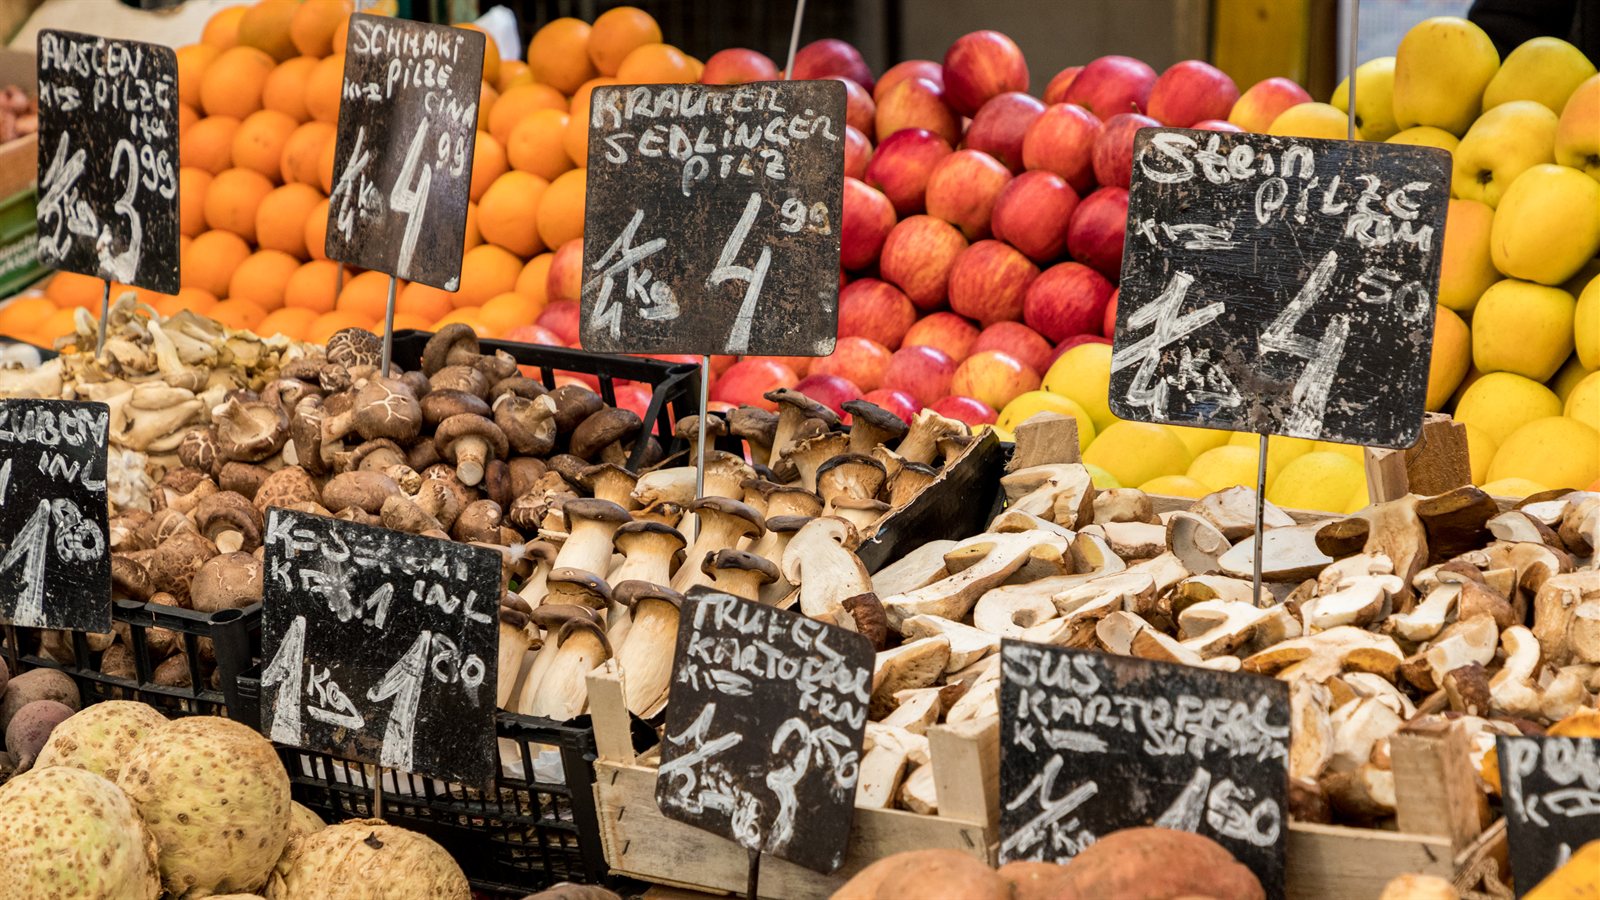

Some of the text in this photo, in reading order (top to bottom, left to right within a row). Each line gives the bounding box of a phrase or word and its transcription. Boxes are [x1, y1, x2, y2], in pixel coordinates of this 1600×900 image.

[140, 144, 176, 199] 99
[390, 116, 432, 280] 4
[436, 131, 465, 177] 99
[705, 191, 772, 354] 4
[1258, 250, 1351, 439] 4
